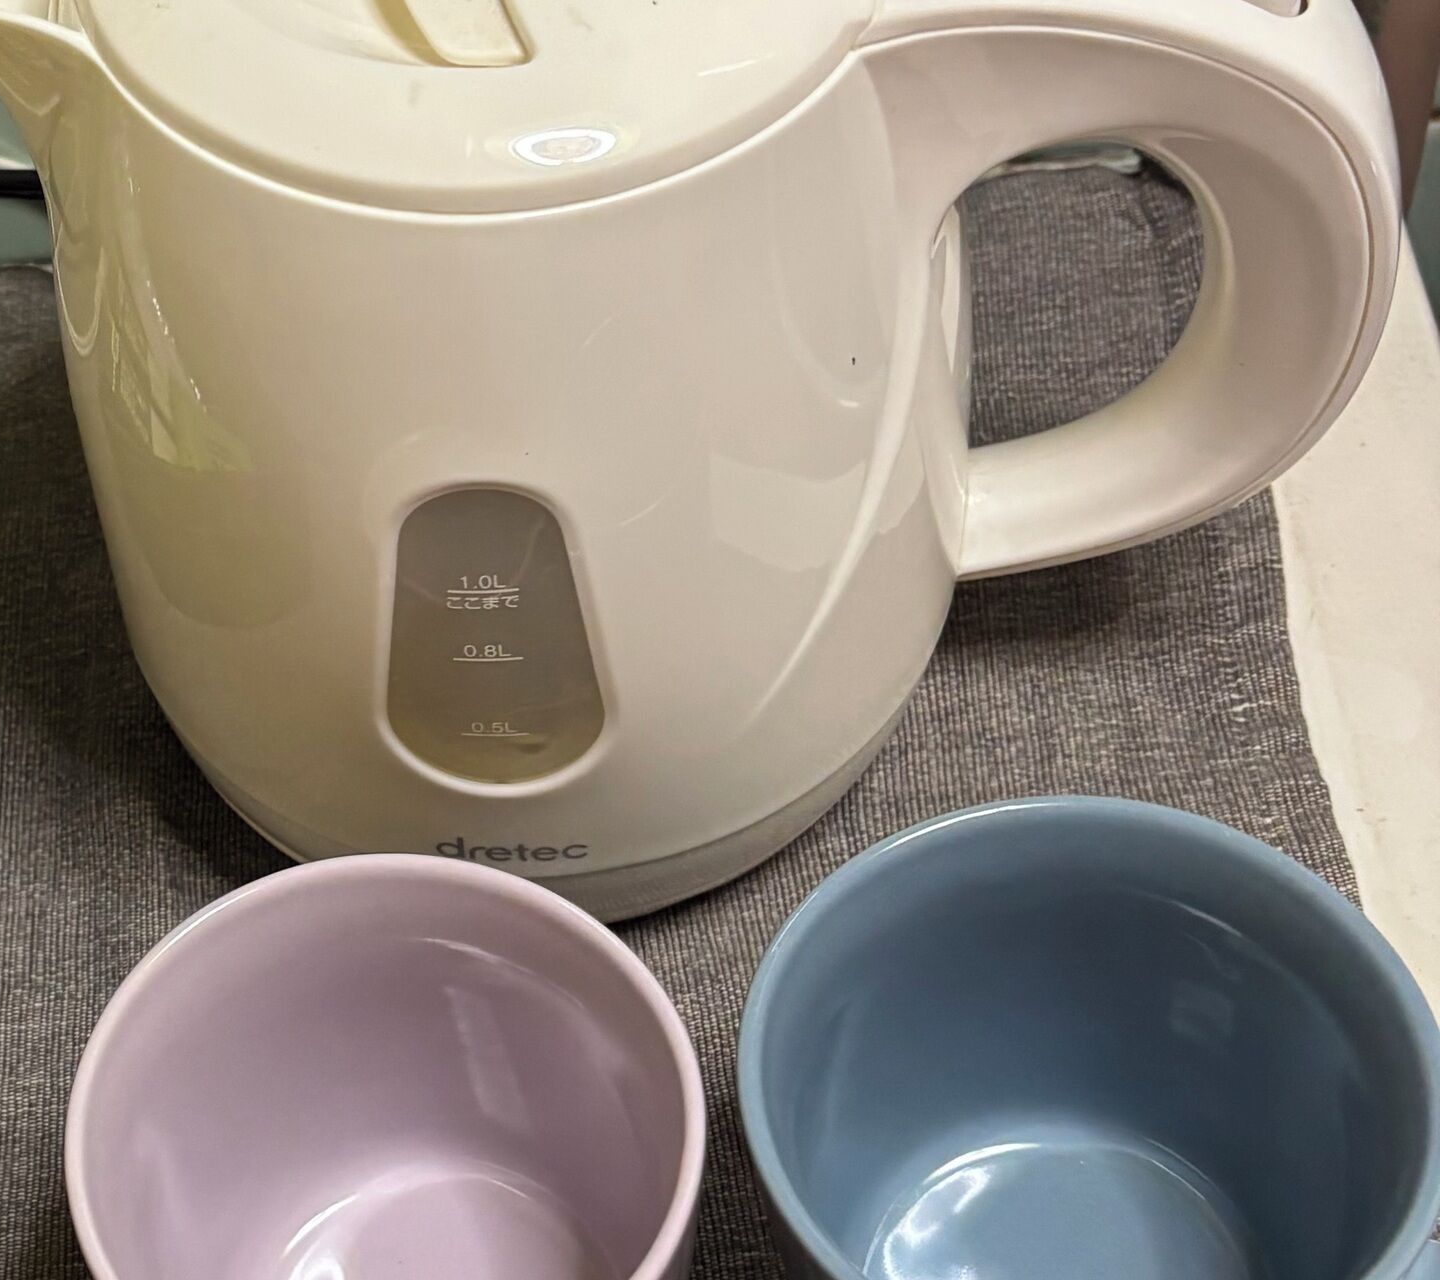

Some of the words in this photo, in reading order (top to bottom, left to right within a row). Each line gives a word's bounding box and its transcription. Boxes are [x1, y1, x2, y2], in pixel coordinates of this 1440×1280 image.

[459, 574, 507, 590] 1.0L
[446, 594, 520, 610] ここまで
[462, 644, 512, 658] 0.8L
[470, 722, 518, 734] 0.5L
[435, 837, 589, 863] dretec
